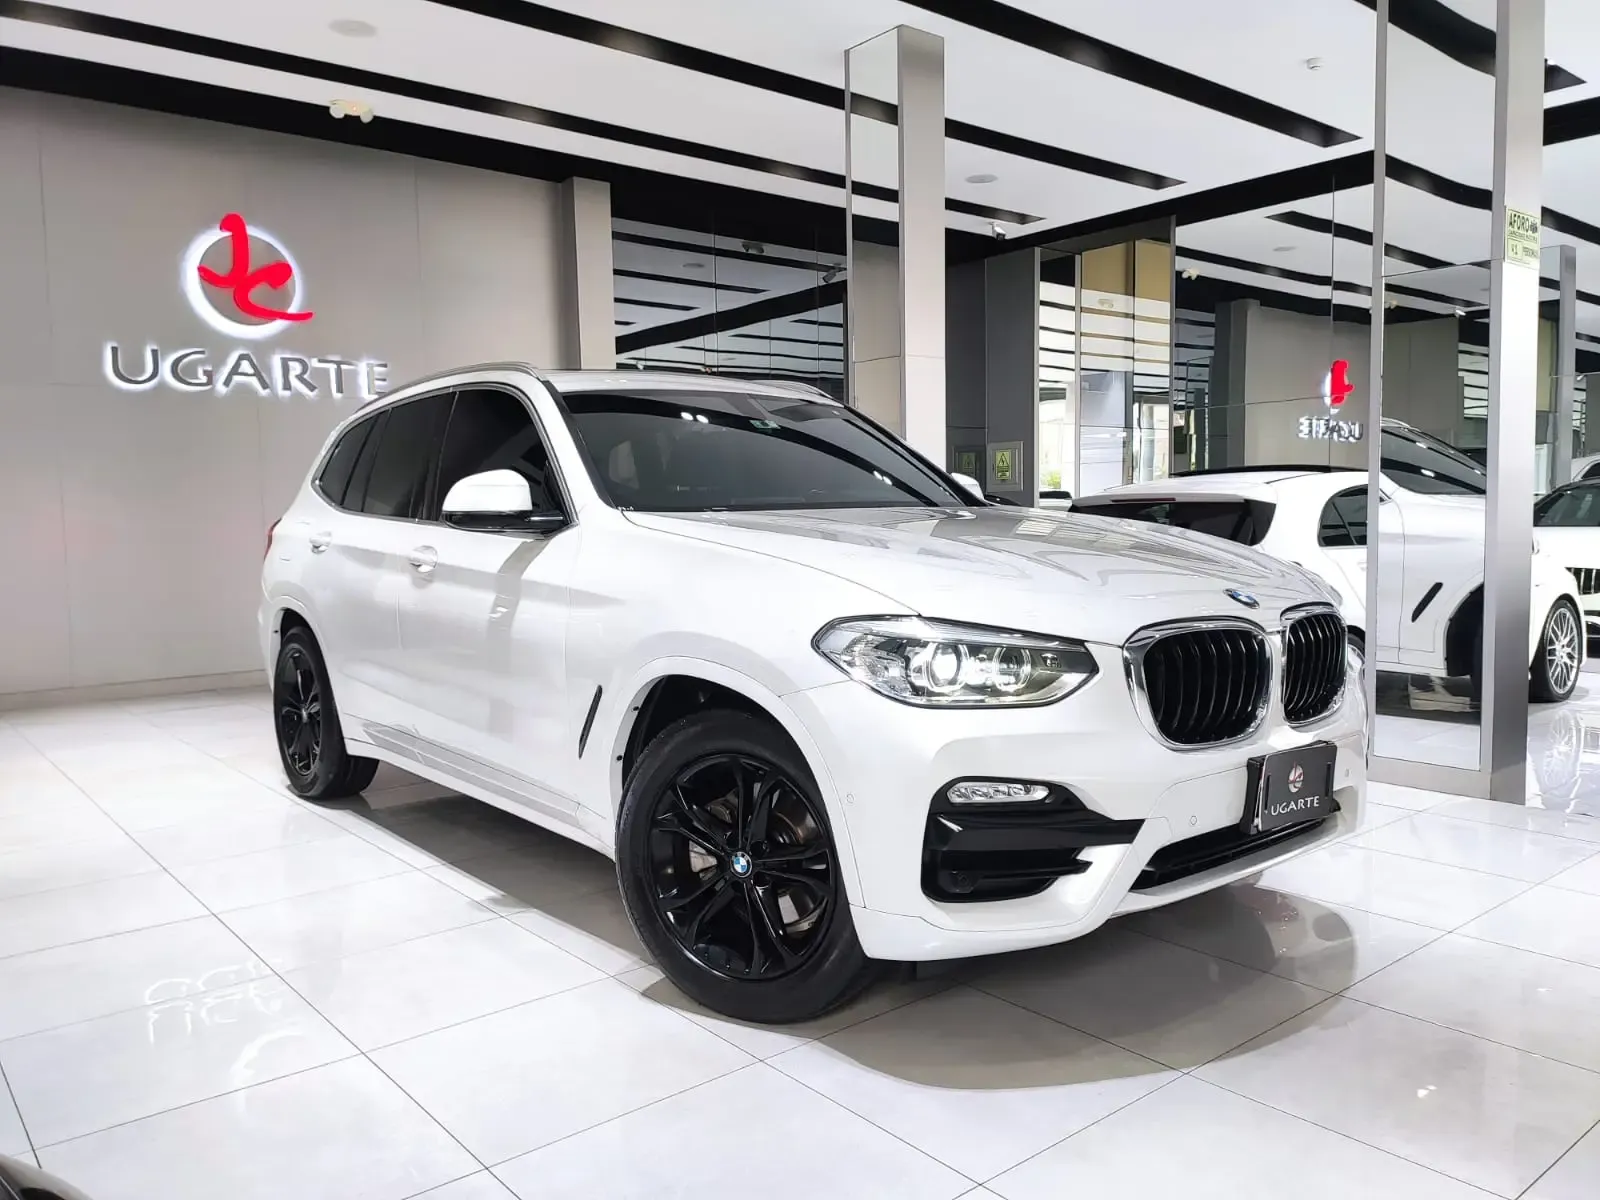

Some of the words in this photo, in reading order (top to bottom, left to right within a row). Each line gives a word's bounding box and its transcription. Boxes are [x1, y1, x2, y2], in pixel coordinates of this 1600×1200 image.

[1508, 212, 1530, 232] AFORO
[105, 344, 388, 397] UGARTE
[1271, 796, 1320, 816] UGARTE
